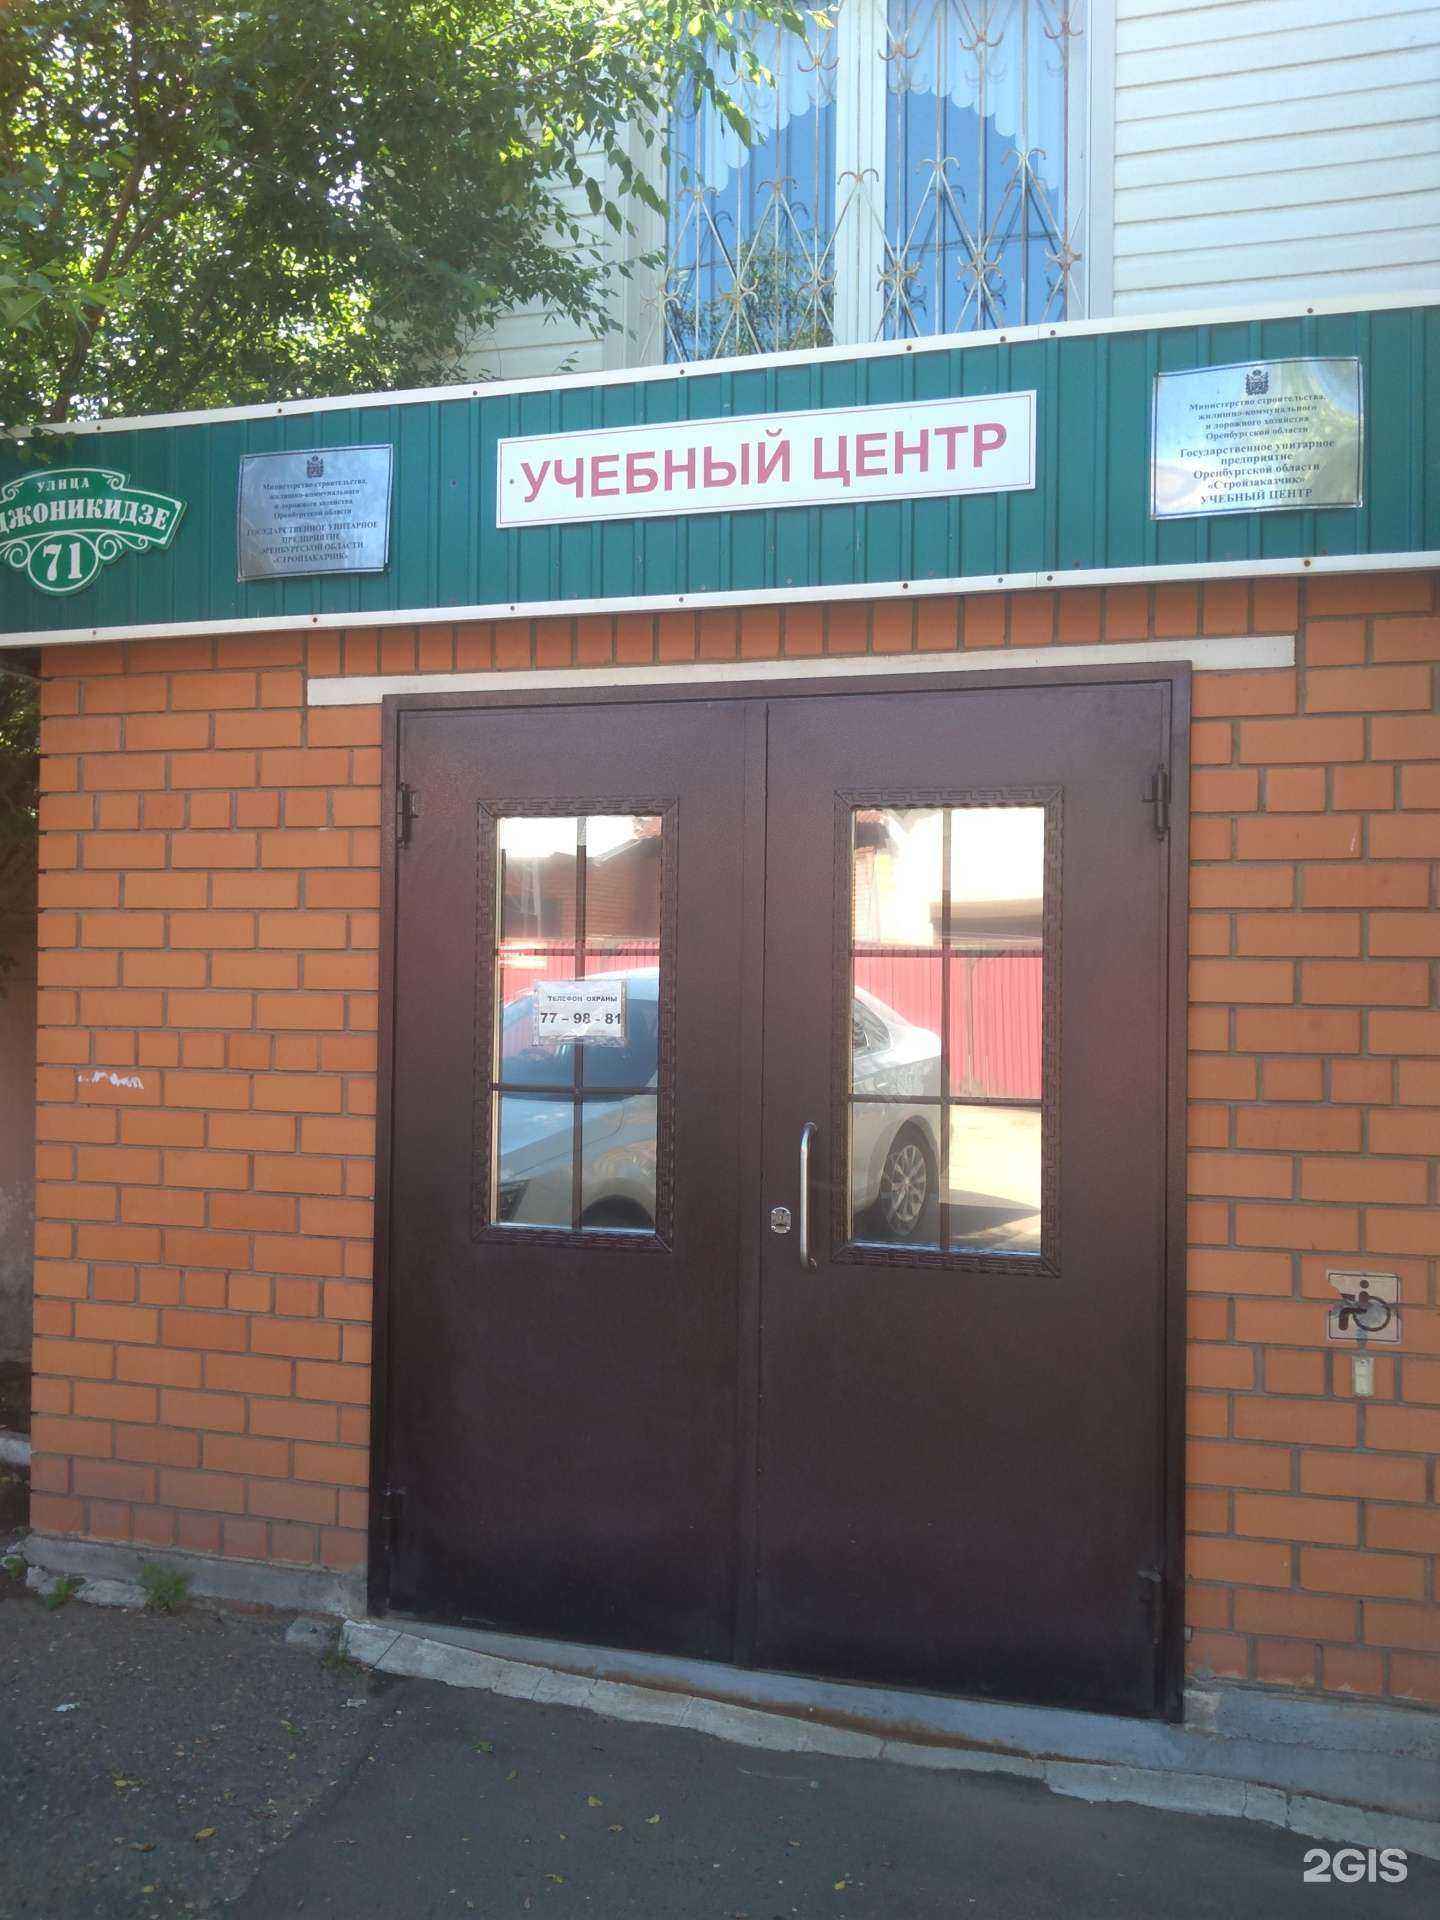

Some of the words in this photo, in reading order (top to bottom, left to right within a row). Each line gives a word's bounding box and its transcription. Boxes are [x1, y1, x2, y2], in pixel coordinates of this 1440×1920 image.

[1189, 398, 1255, 412] Министерство
[1198, 404, 1317, 420] жилищно-коммунального
[1213, 419, 1262, 432] дорожного
[1264, 415, 1309, 426] хозяйства
[1206, 429, 1270, 441] Оренбургской
[1272, 426, 1309, 437] области
[1180, 443, 1272, 458] Государственное
[1274, 440, 1336, 453] унитарное
[520, 428, 792, 503] УЧЕБНЫЙ
[813, 422, 1008, 487] ЦЕНТР
[1221, 453, 1293, 467] предприятие
[1193, 466, 1272, 480] Оренбургской
[1275, 463, 1320, 474] области
[36, 477, 90, 493] УЛИЦА
[1201, 489, 1266, 504] УЧЕБНЫЙ
[1269, 488, 1313, 500] ЦЕНТР
[247, 524, 326, 536] ГОСУДАРСТВЕННОЕ
[328, 521, 378, 532] УНИТАРНОЕ
[281, 533, 340, 543] ПРЕДПРИЯТИЕ
[43, 542, 82, 581] 71
[586, 994, 618, 1002] ОХРАНЫ
